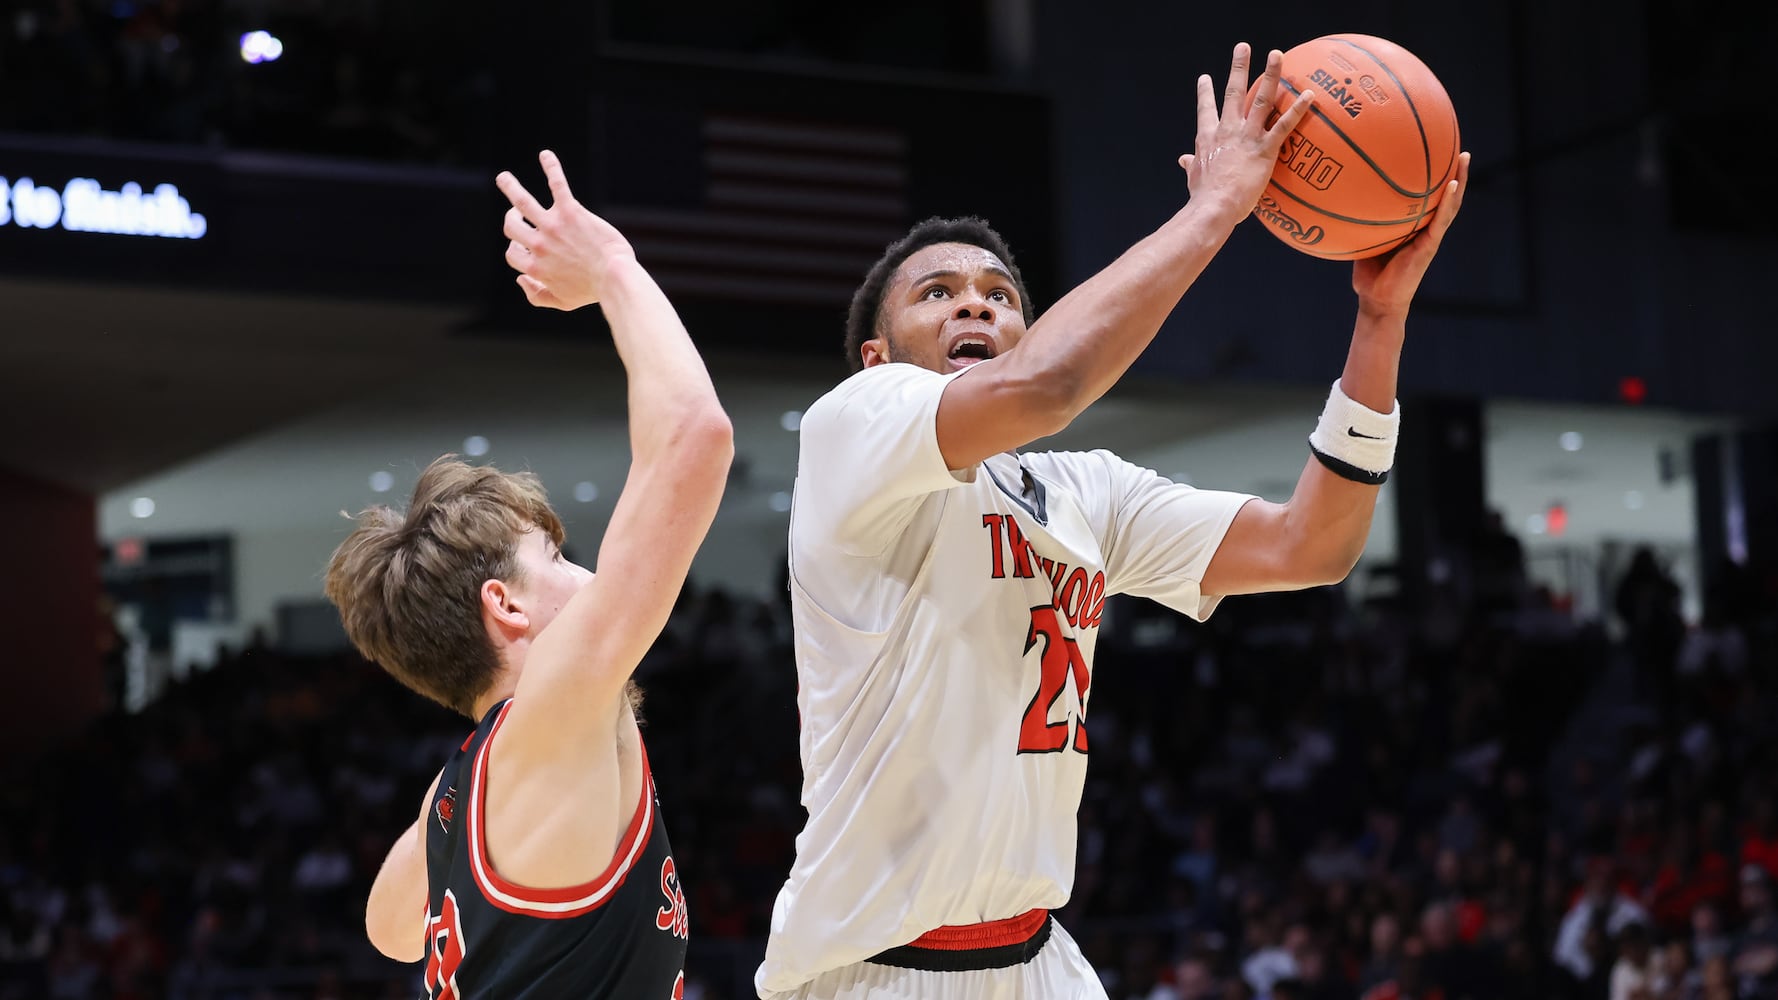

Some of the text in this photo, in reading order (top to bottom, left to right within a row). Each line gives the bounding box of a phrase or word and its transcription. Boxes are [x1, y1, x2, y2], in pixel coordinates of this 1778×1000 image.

[1309, 68, 1354, 107] NFHS
[1265, 106, 1344, 191] OHS
[12, 176, 62, 229] to
